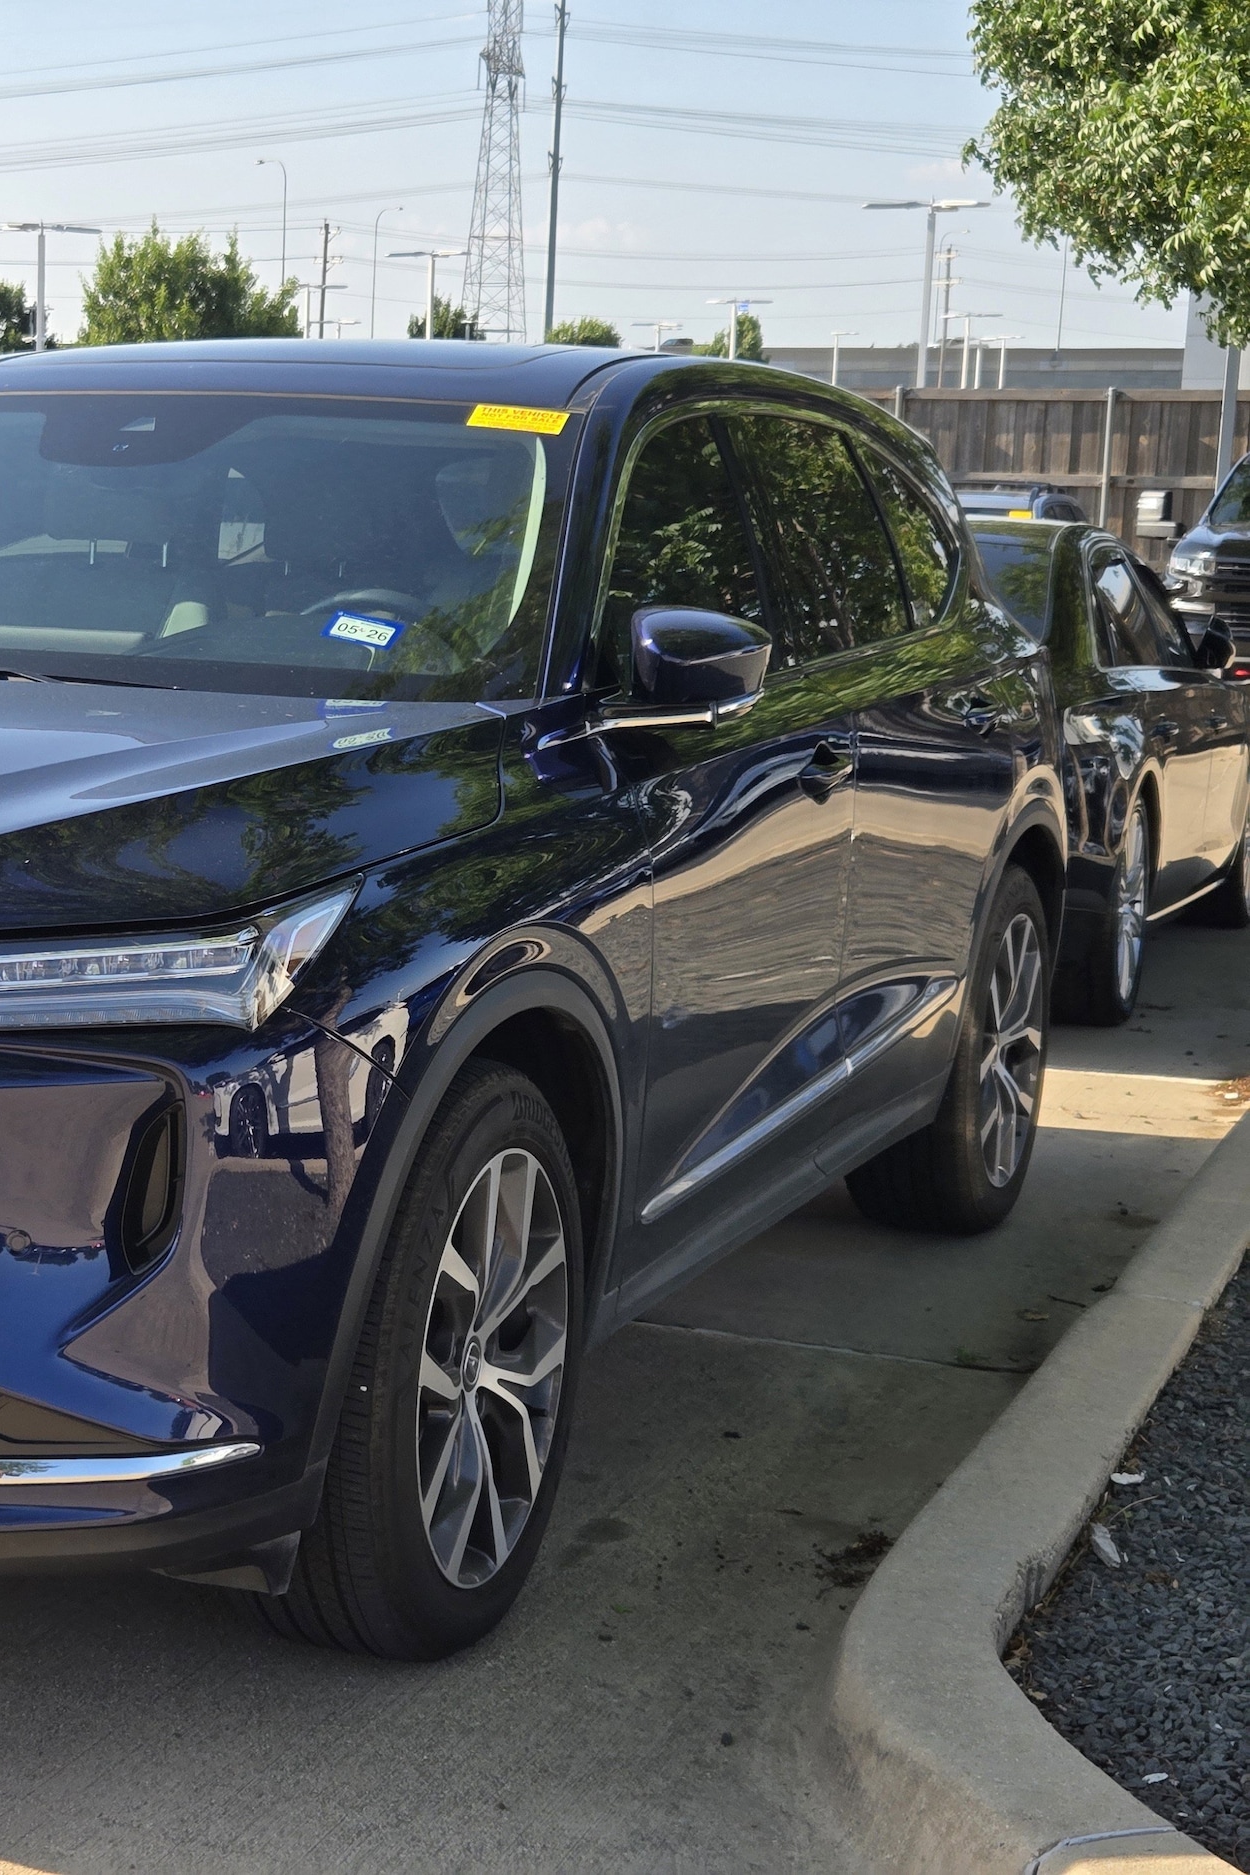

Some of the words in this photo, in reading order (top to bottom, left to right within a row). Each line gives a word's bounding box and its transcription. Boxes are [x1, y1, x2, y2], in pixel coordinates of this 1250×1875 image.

[481, 407, 508, 415] THIS
[513, 409, 565, 421] VEHICLE
[337, 622, 358, 635] 05
[366, 629, 389, 642] 26
